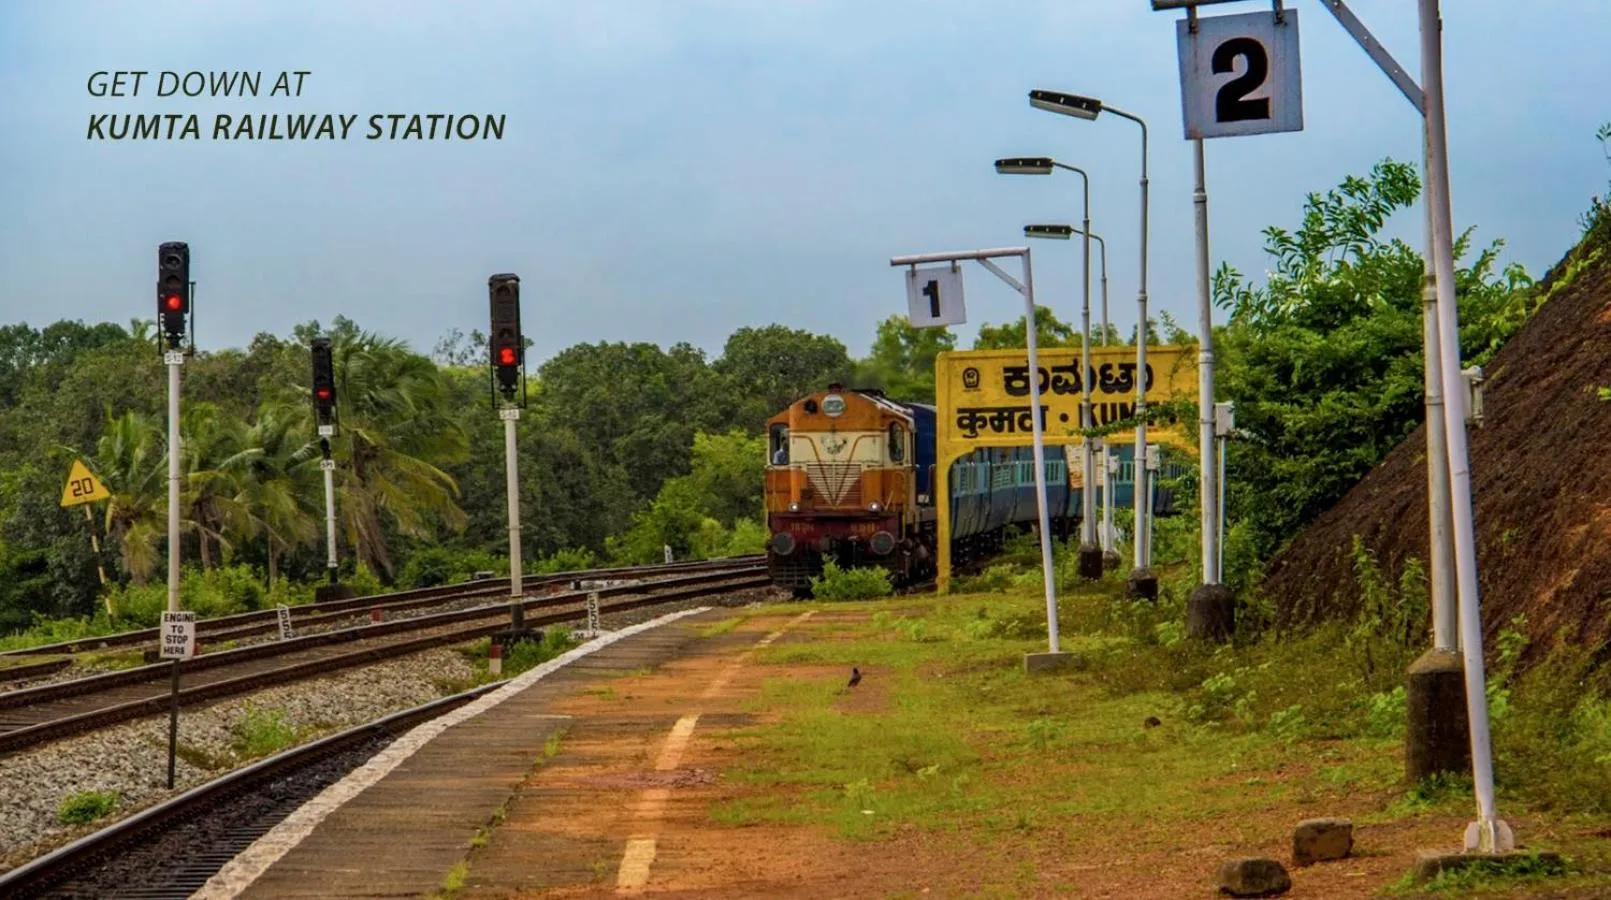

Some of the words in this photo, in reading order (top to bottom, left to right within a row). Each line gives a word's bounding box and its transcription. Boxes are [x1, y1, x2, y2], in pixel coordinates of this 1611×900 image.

[1212, 37, 1270, 123] 2
[922, 280, 941, 318] 1
[71, 477, 94, 497] 20
[164, 613, 195, 622] ENGINE
[171, 625, 184, 634] TO
[165, 635, 188, 644] STOP
[164, 646, 185, 655] HERE
